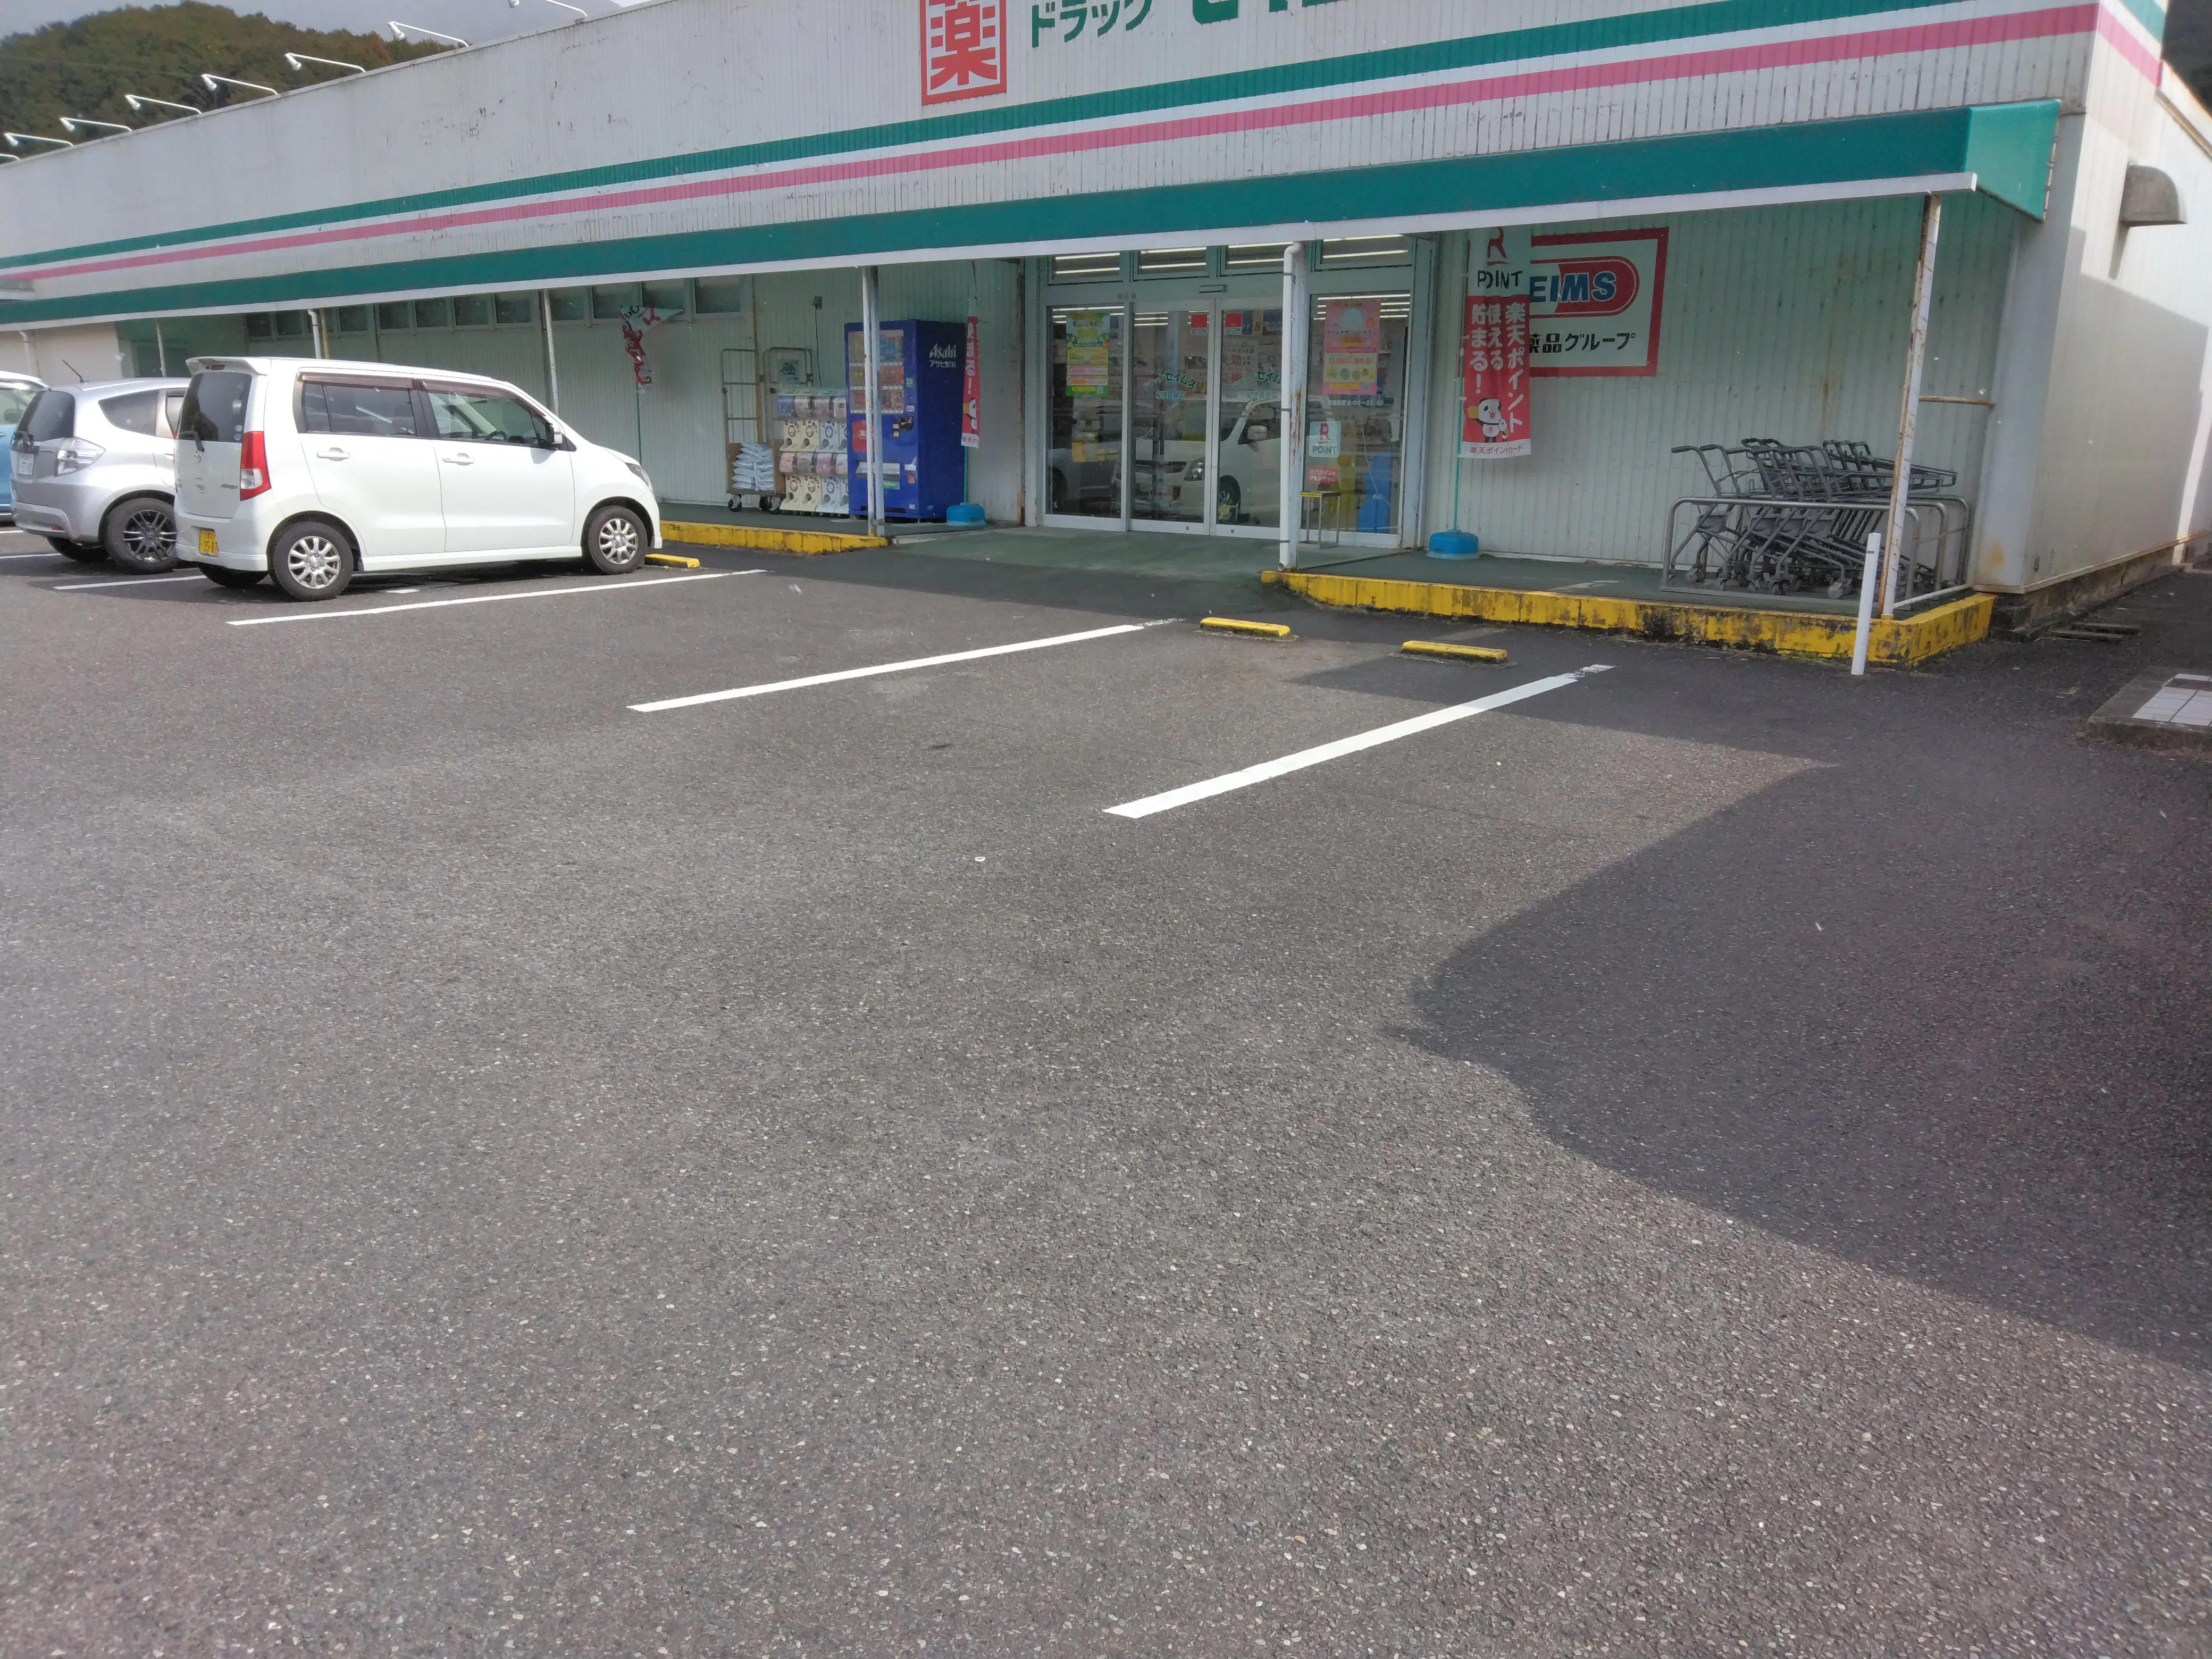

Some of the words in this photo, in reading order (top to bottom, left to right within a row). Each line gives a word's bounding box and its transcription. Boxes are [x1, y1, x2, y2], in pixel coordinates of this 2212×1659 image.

[929, 343, 957, 359] Asahi
[929, 359, 957, 368] アサヒ飲料
[1505, 302, 1526, 433] 楽天ポイント
[1312, 445, 1337, 455] POINT
[1470, 443, 1523, 455] 楽天ポイントカード
